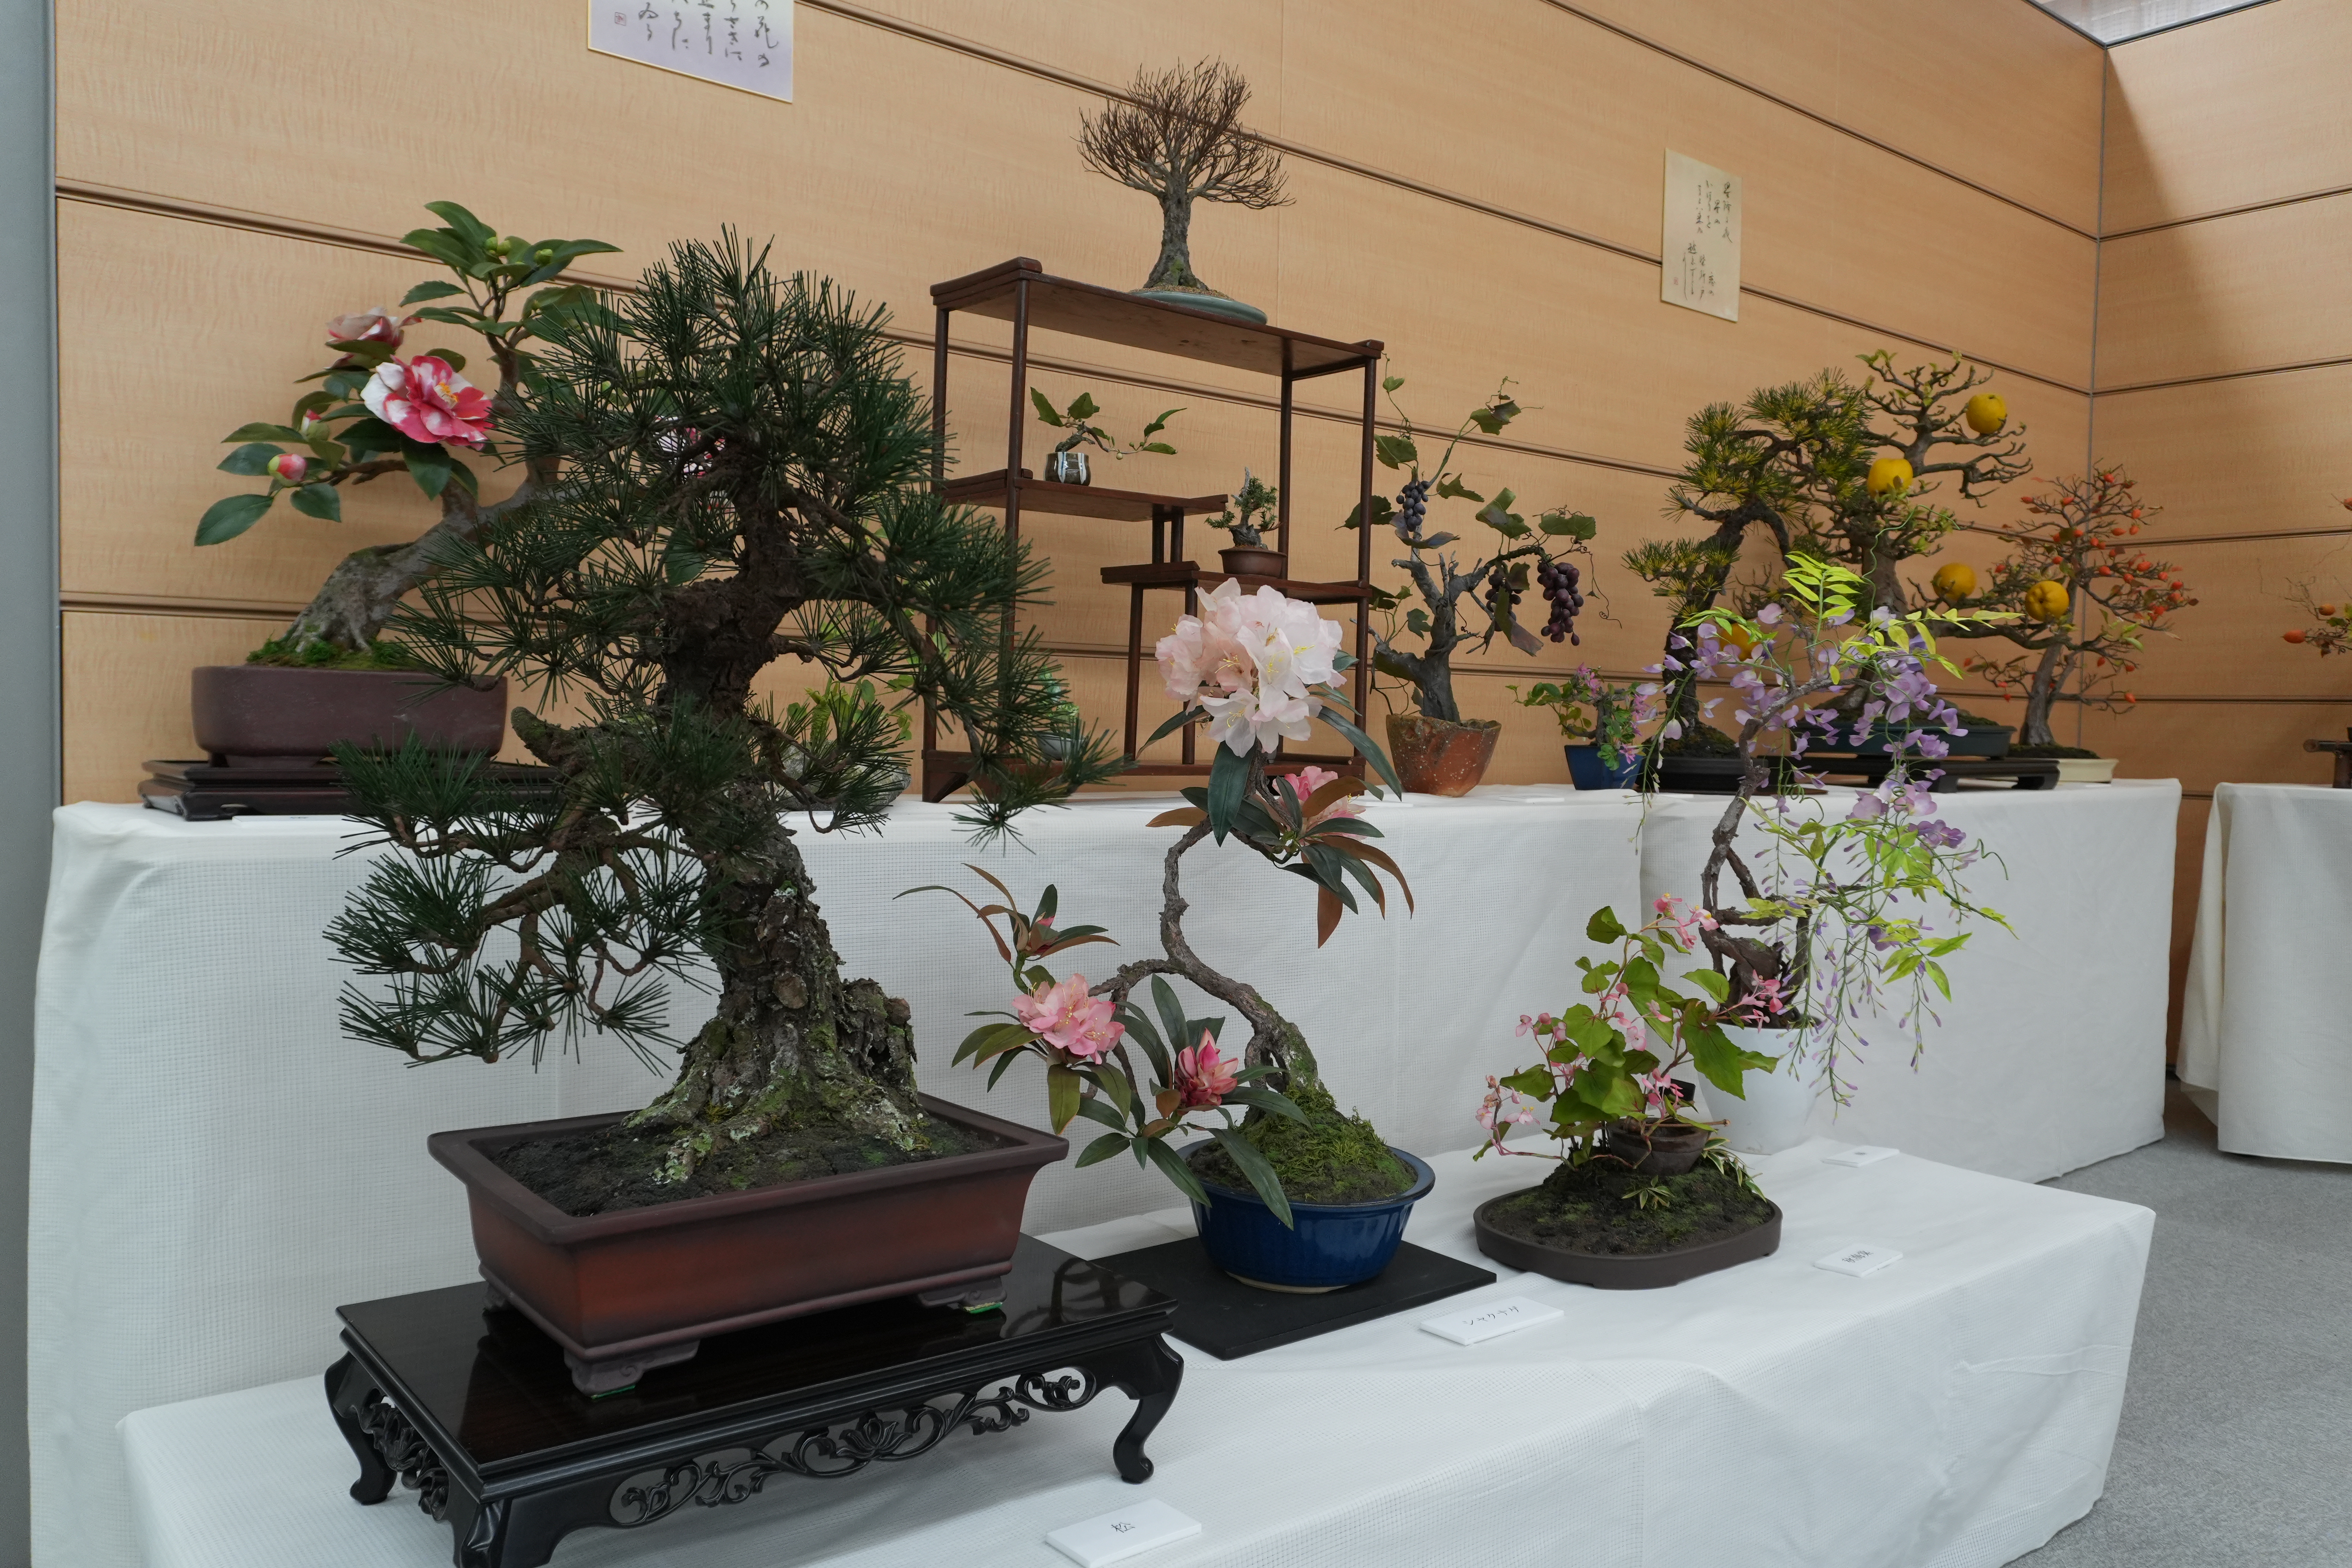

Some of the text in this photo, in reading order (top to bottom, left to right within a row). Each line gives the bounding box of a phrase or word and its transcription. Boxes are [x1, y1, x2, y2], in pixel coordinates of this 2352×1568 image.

[1462, 1306, 1519, 1325] シャクナゲ
[1111, 1522, 1136, 1533] 松
